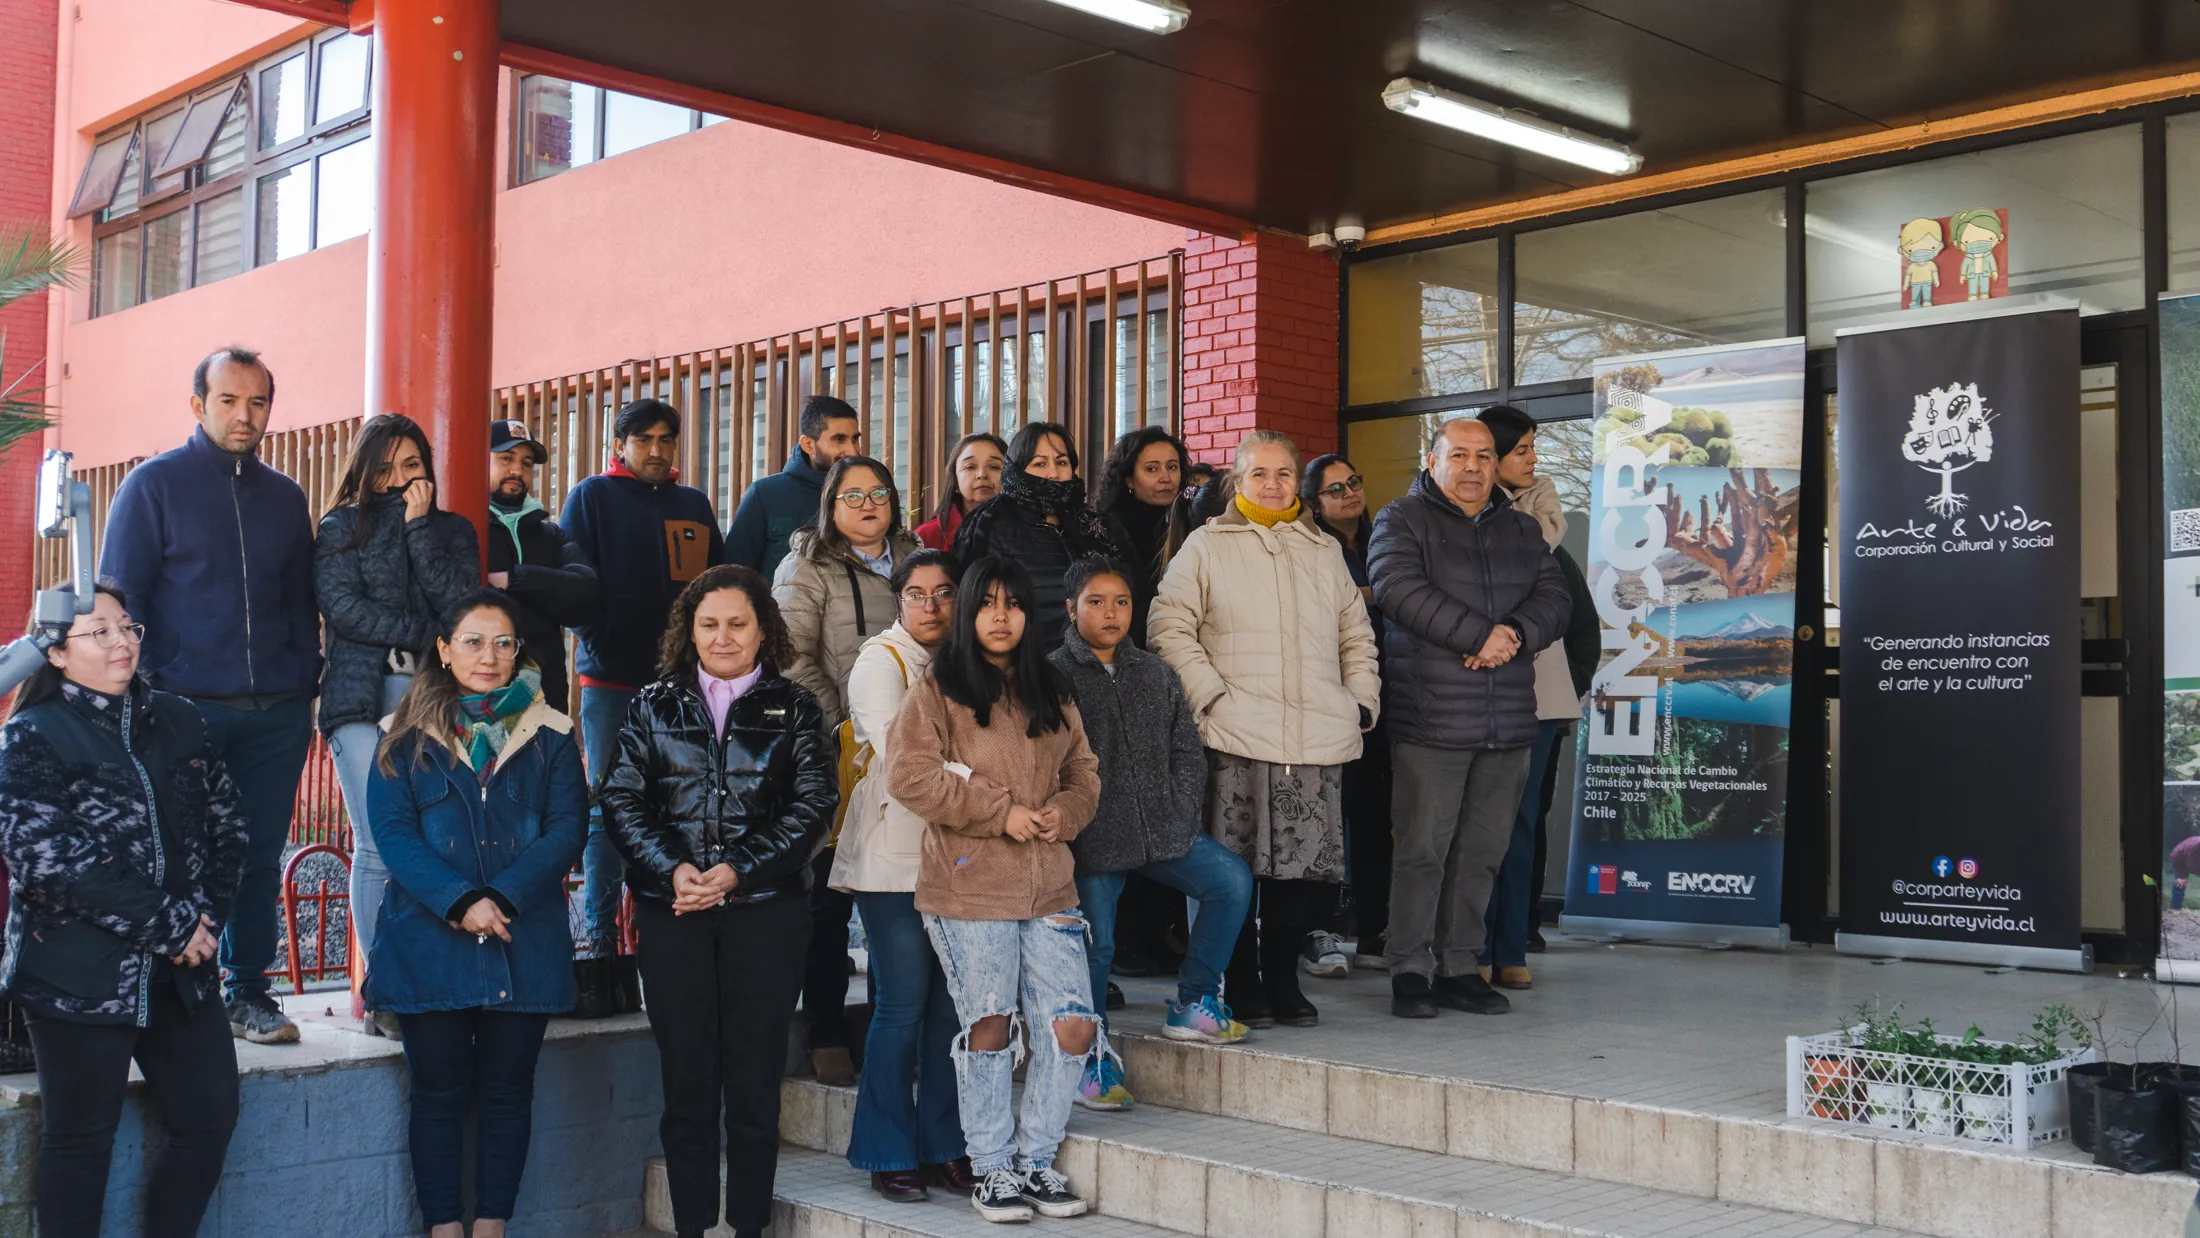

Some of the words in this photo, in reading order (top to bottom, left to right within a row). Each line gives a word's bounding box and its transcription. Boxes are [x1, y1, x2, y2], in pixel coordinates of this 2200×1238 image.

[1856, 519, 1937, 541] Arte
[1952, 518, 1967, 537] &
[1979, 505, 2052, 532] Vida
[1855, 541, 1937, 558] Corporación
[1941, 538, 1994, 553] Cultural
[1998, 540, 2007, 552] y
[2012, 535, 2054, 549] Social
[1588, 384, 1673, 756] ENCCRV
[1863, 634, 1964, 651] “Generando
[1967, 631, 2050, 648] instancias
[1881, 656, 1903, 671] de
[1907, 654, 1992, 670] encuentro
[1995, 656, 2029, 669] con
[1878, 676, 1893, 691] el
[1896, 676, 1929, 691] arte
[1933, 679, 1943, 694] y
[1946, 675, 1962, 690] la
[1662, 676, 1674, 756] www.enccrv.cl
[1586, 763, 1635, 776] Estrategia
[1637, 764, 1681, 775] Nacional
[1684, 766, 1697, 775] de
[1698, 765, 1738, 776] Cambio
[1585, 777, 1633, 788] Climático
[1634, 780, 1641, 790] y
[1643, 779, 1687, 789] Recursos
[1689, 780, 1768, 792] Vegetacionales
[1584, 791, 1610, 801] 2017
[1620, 791, 1647, 802] 2025
[1583, 805, 1617, 818] Chile
[1667, 871, 1756, 894] ENCCRV
[1892, 879, 2021, 901] @corparteyvida
[1879, 911, 2036, 932] www.arteyvida.cl
